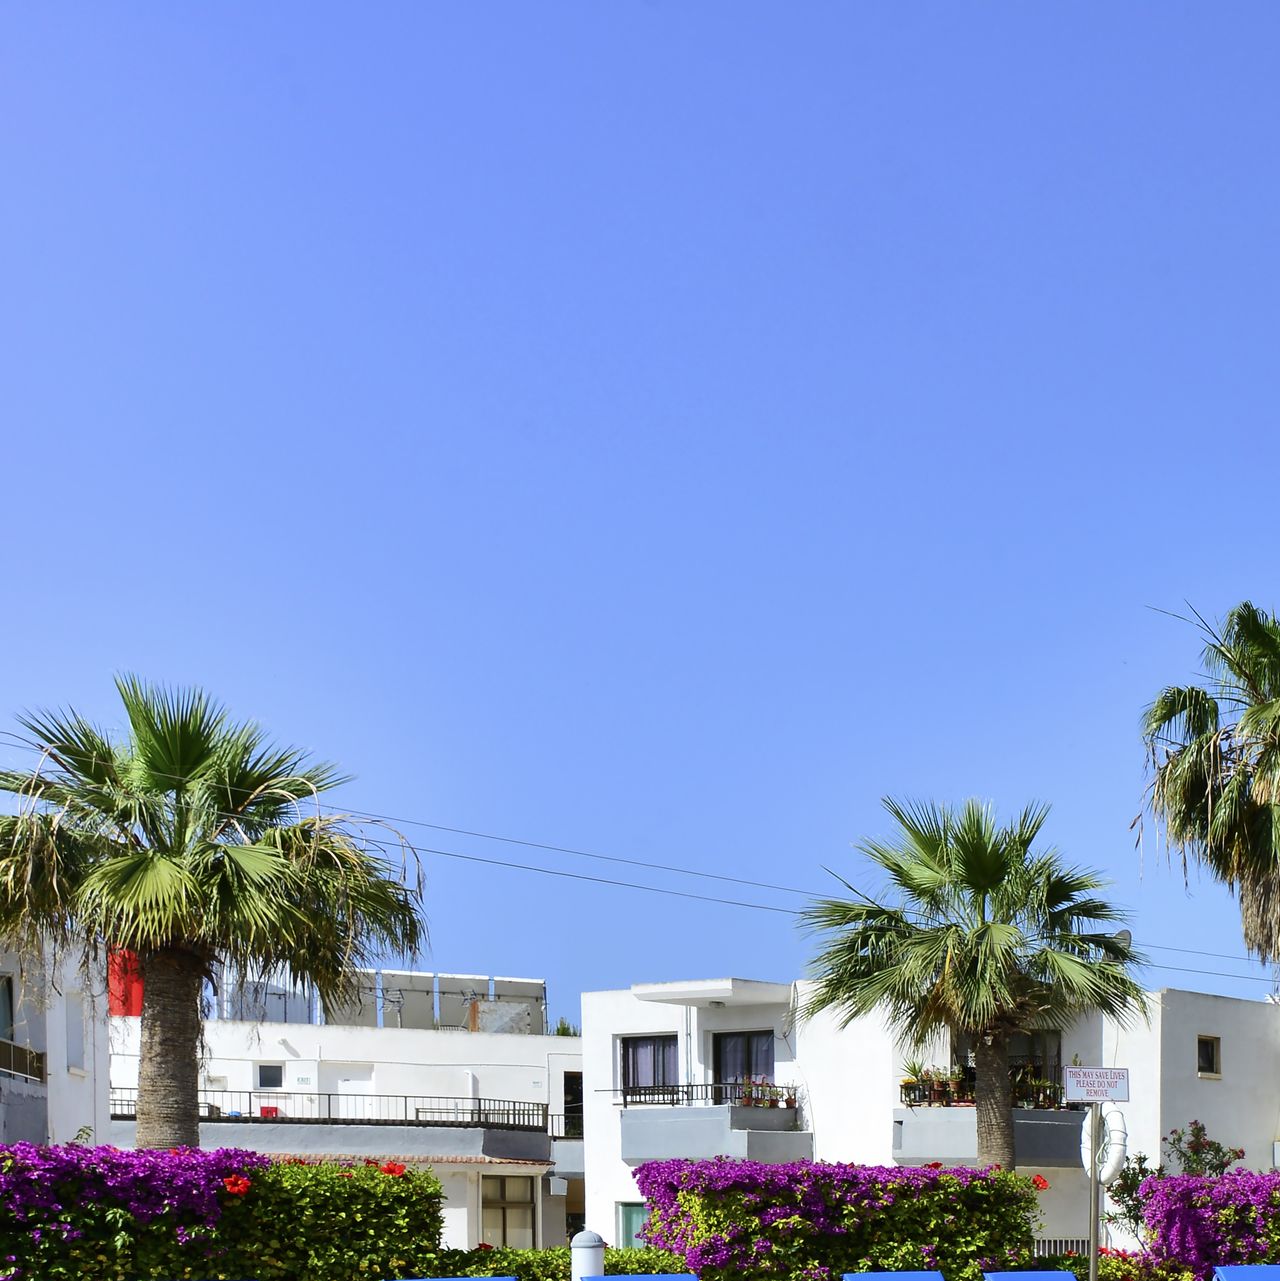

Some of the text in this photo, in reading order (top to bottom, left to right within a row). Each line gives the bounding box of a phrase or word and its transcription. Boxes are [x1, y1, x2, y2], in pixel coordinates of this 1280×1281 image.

[1068, 1070, 1125, 1080] THIS MAY SAVE LIVES
[1076, 1079, 1118, 1089] PLEASE DO NOT
[1086, 1089, 1109, 1097] REMOVE
